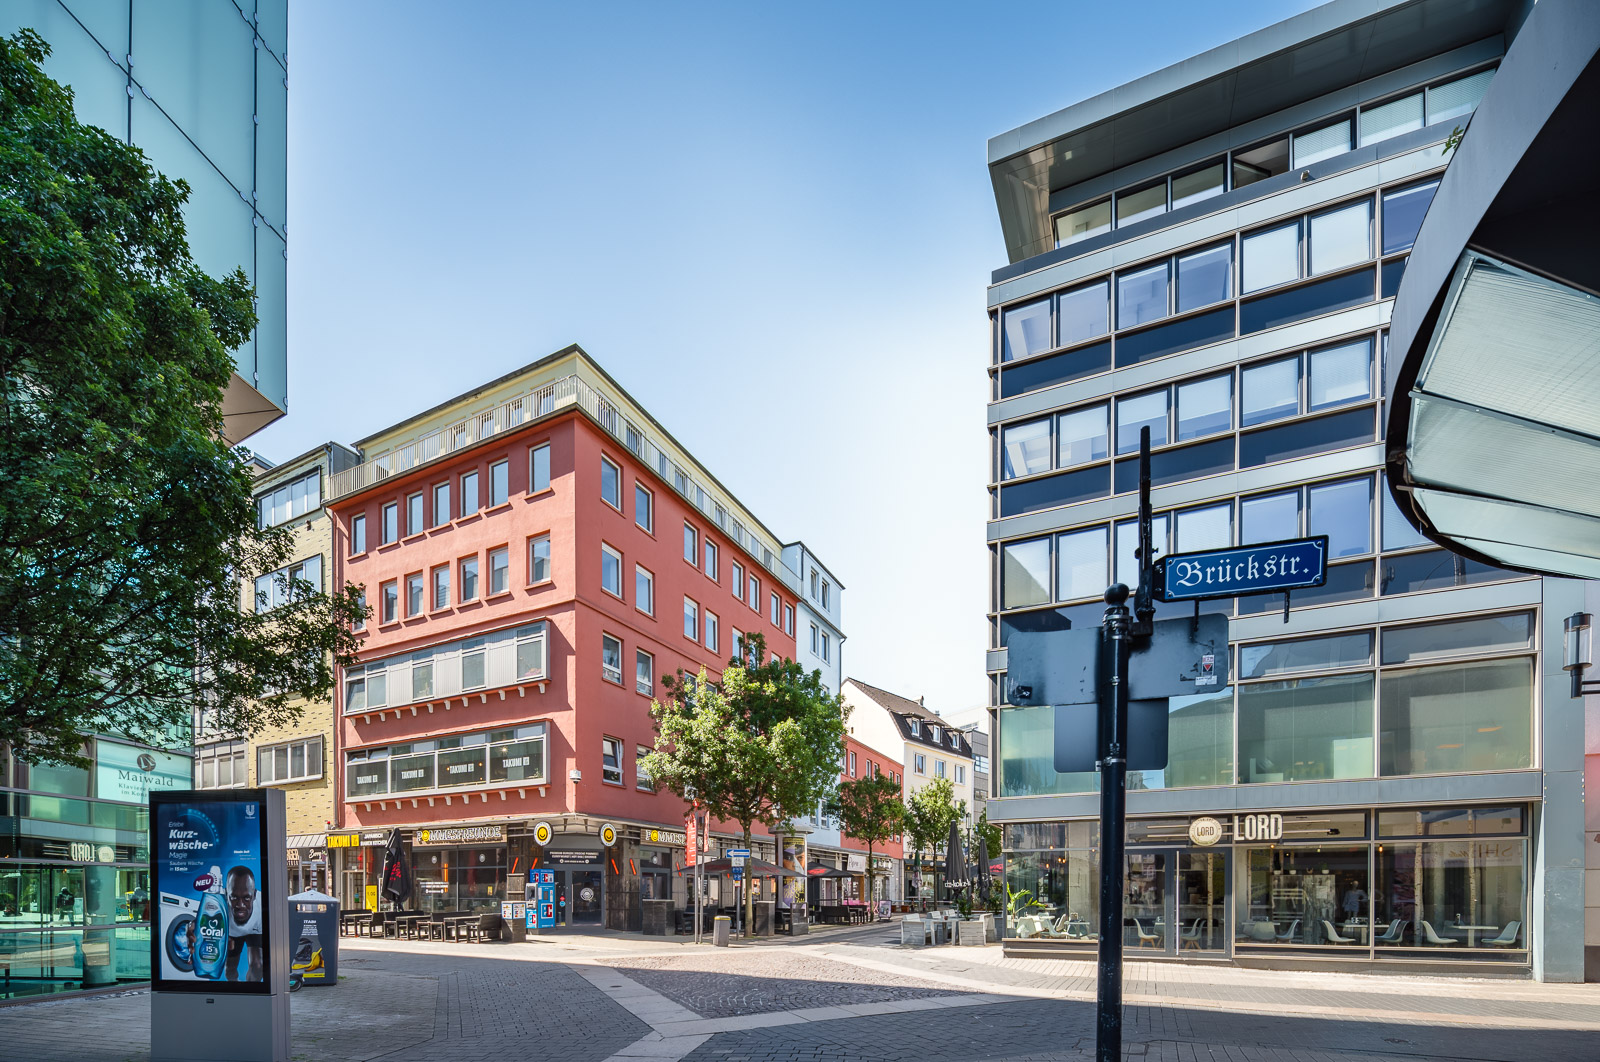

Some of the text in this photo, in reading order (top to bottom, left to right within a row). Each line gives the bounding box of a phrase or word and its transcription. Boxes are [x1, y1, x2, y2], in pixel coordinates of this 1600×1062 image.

[1176, 554, 1309, 587] Brückstr.
[503, 758, 522, 768] TAKUMI
[450, 764, 467, 774] TAKUMI
[118, 770, 174, 787] Maiwald
[357, 775, 372, 785] TAKUMI
[402, 770, 417, 780] TAKUMI
[1197, 826, 1215, 836] LORD
[1233, 814, 1283, 840] LORD
[169, 830, 198, 839] Kurz-
[416, 827, 502, 842] POMMESFREUNDE
[169, 840, 214, 850] wäsche-
[327, 835, 350, 848] TAKUMI
[169, 852, 188, 860] Magie
[195, 879, 212, 887] NEU
[200, 926, 224, 937] Coral
